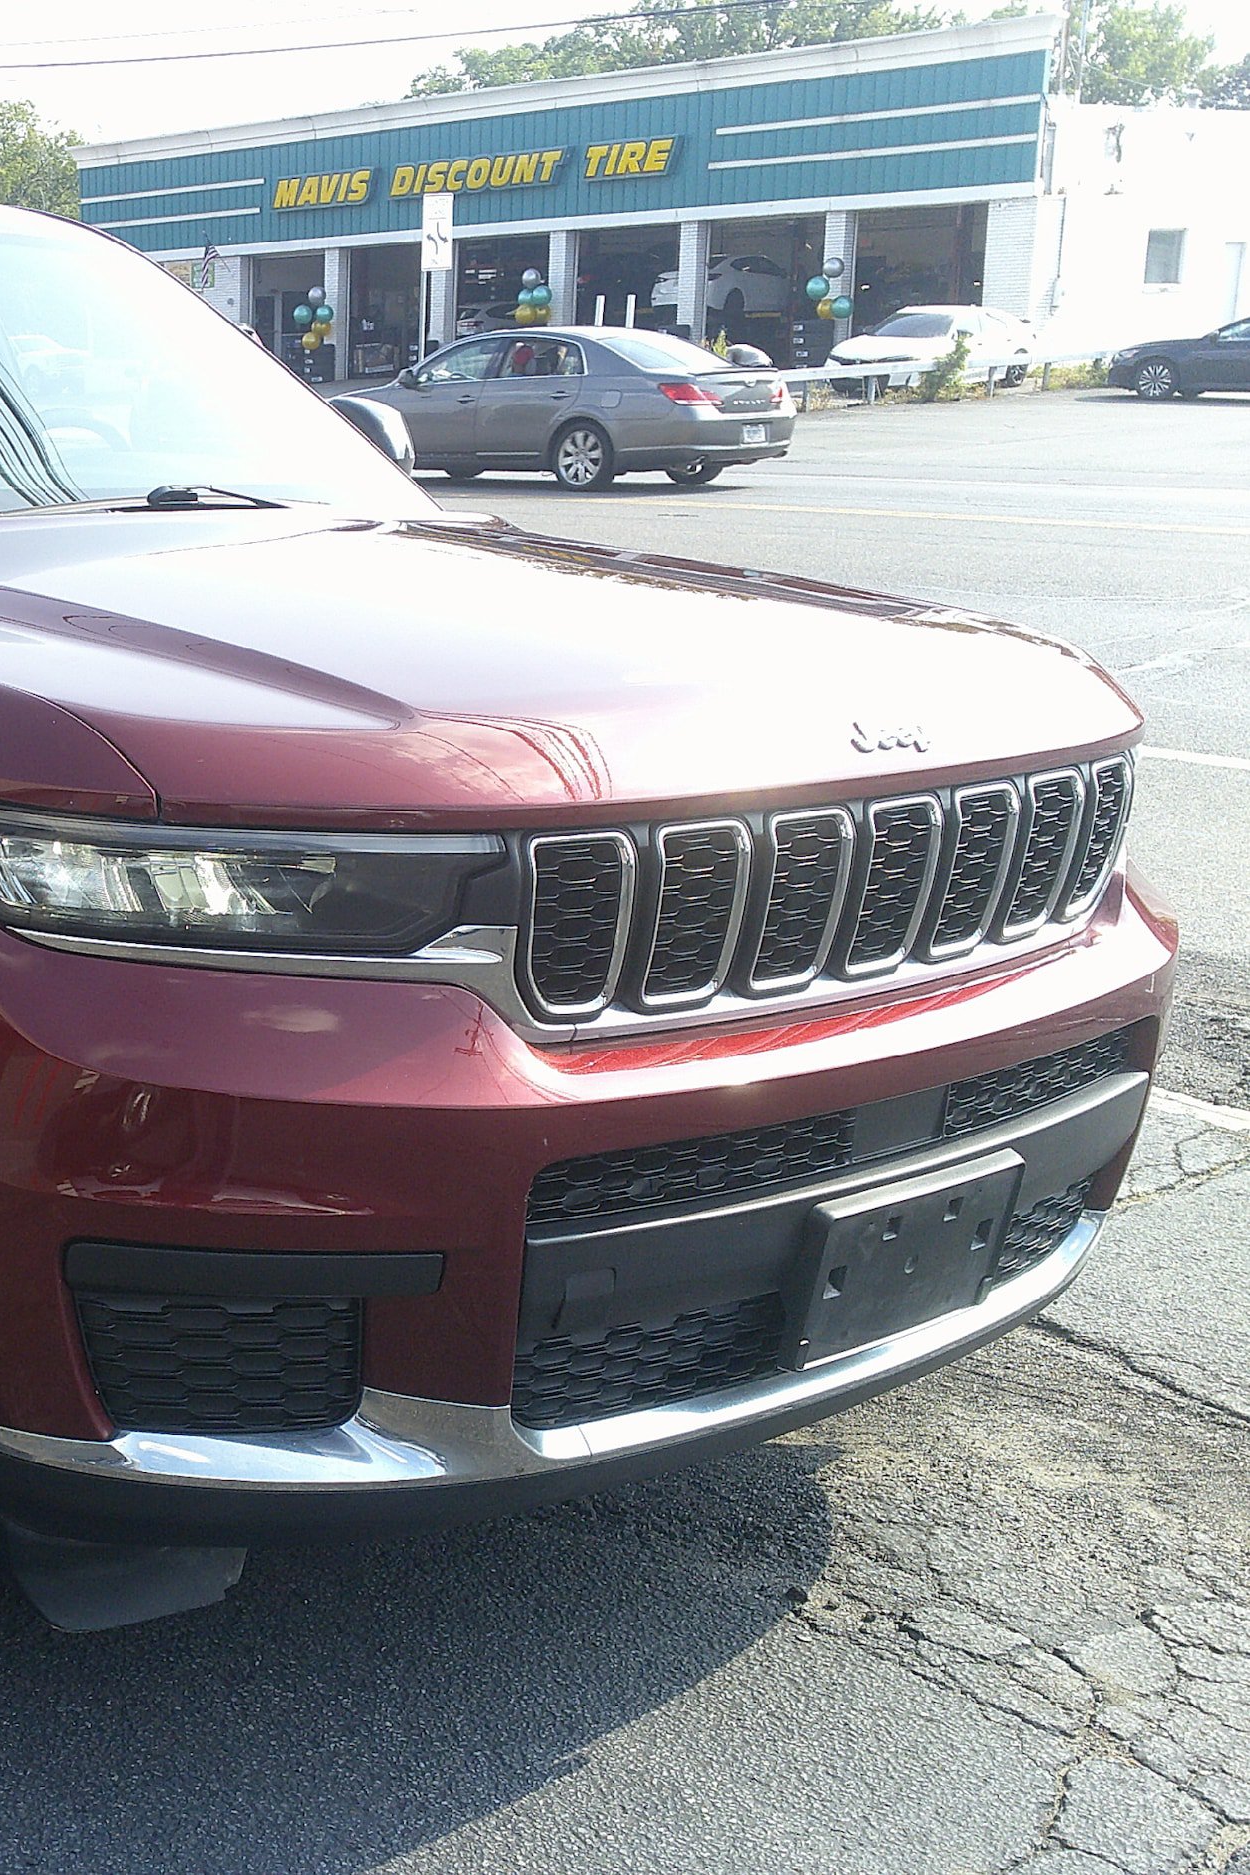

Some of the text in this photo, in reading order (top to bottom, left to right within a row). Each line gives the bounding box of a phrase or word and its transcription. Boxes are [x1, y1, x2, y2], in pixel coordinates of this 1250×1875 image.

[273, 138, 675, 208] MAVIS DISCOUNT TIRE
